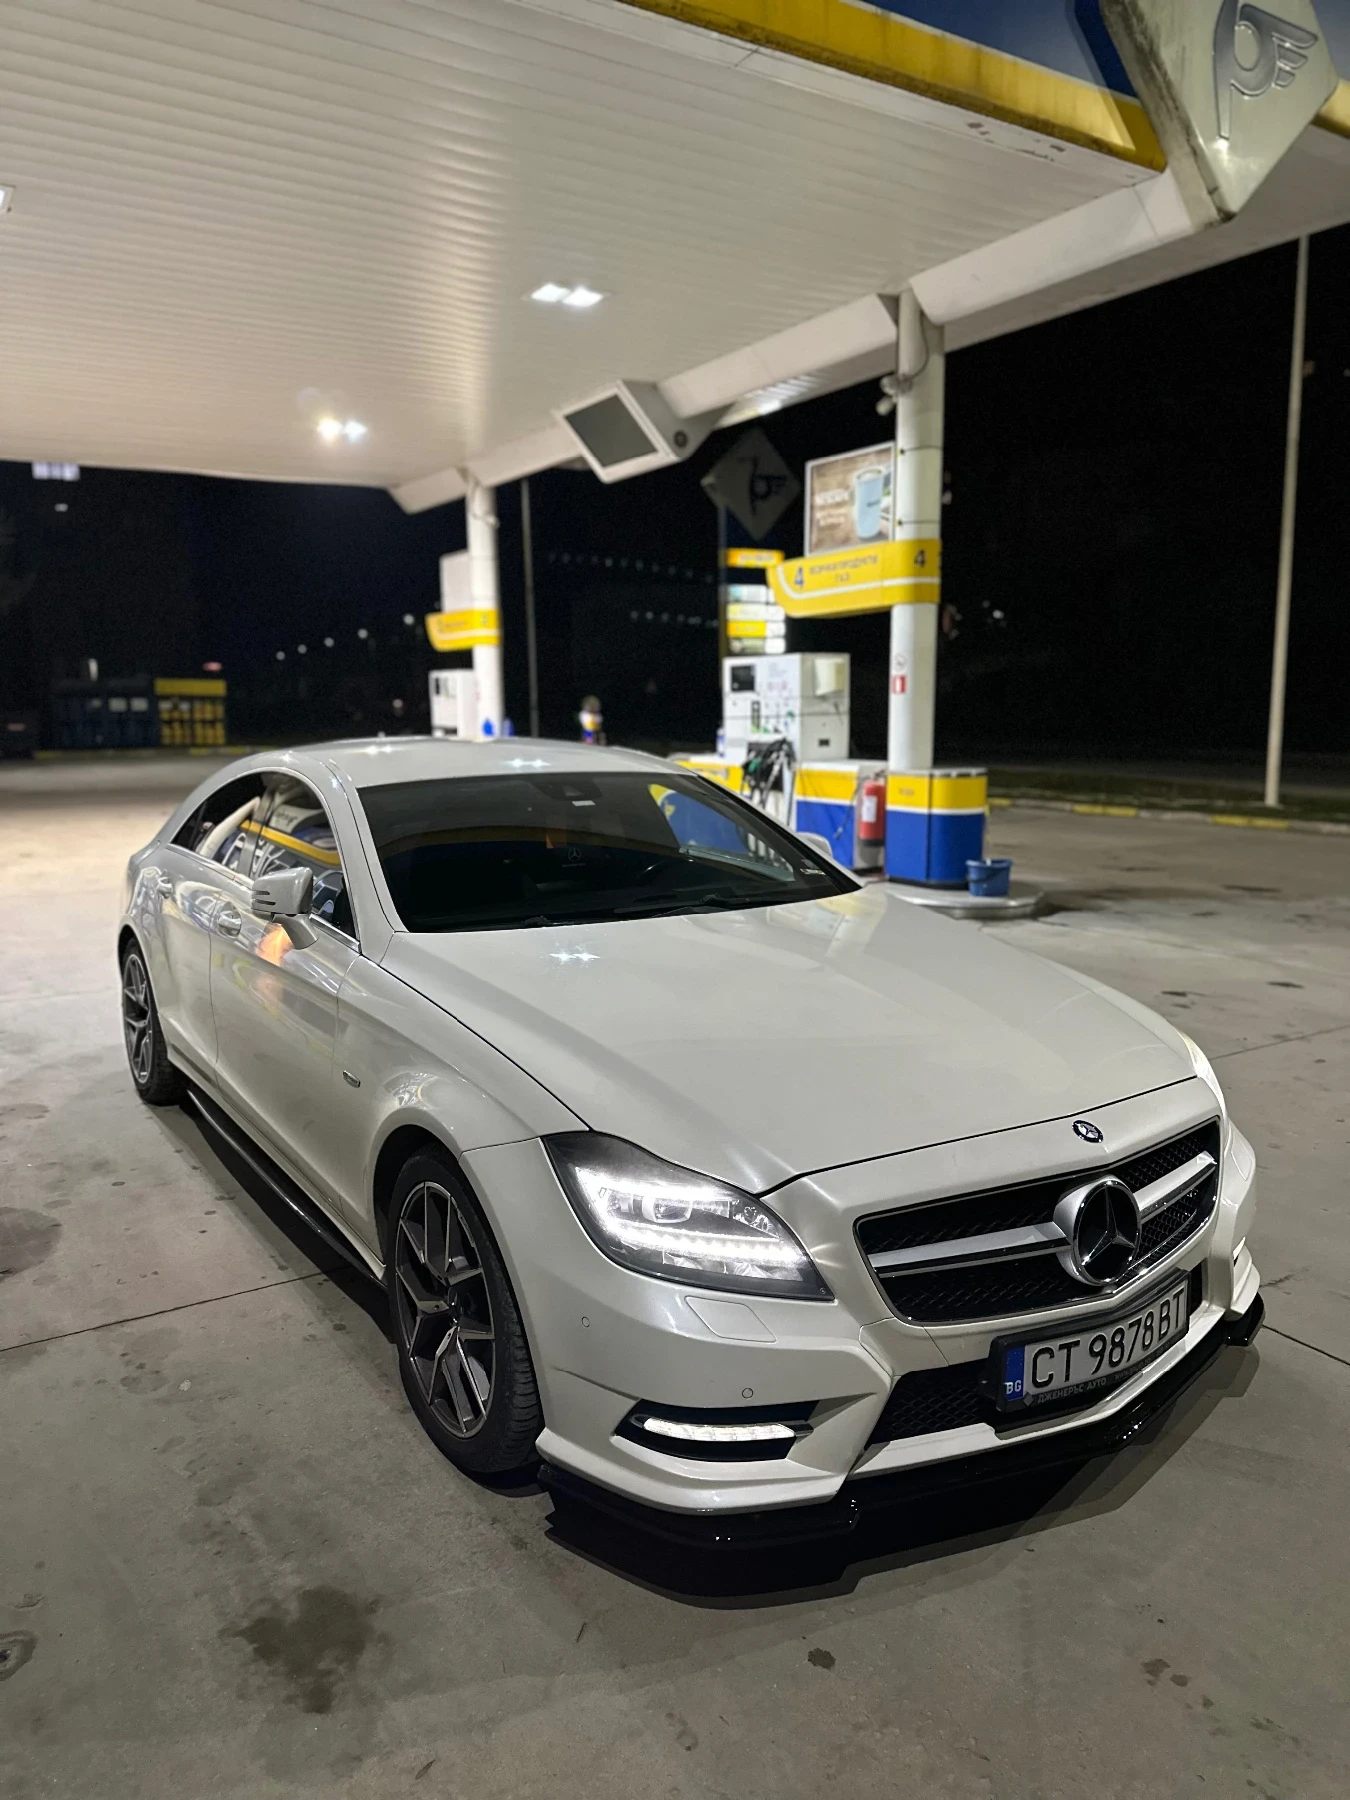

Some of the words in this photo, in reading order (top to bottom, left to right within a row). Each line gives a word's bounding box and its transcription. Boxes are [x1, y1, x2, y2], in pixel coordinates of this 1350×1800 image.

[914, 549, 926, 567] 4
[795, 566, 804, 588] 4
[1032, 1340, 1081, 1389] CT
[1089, 1310, 1154, 1375] 9878
[1158, 1288, 1185, 1341] BT
[1005, 1380, 1022, 1395] BG
[1086, 1377, 1107, 1391] АУТО
